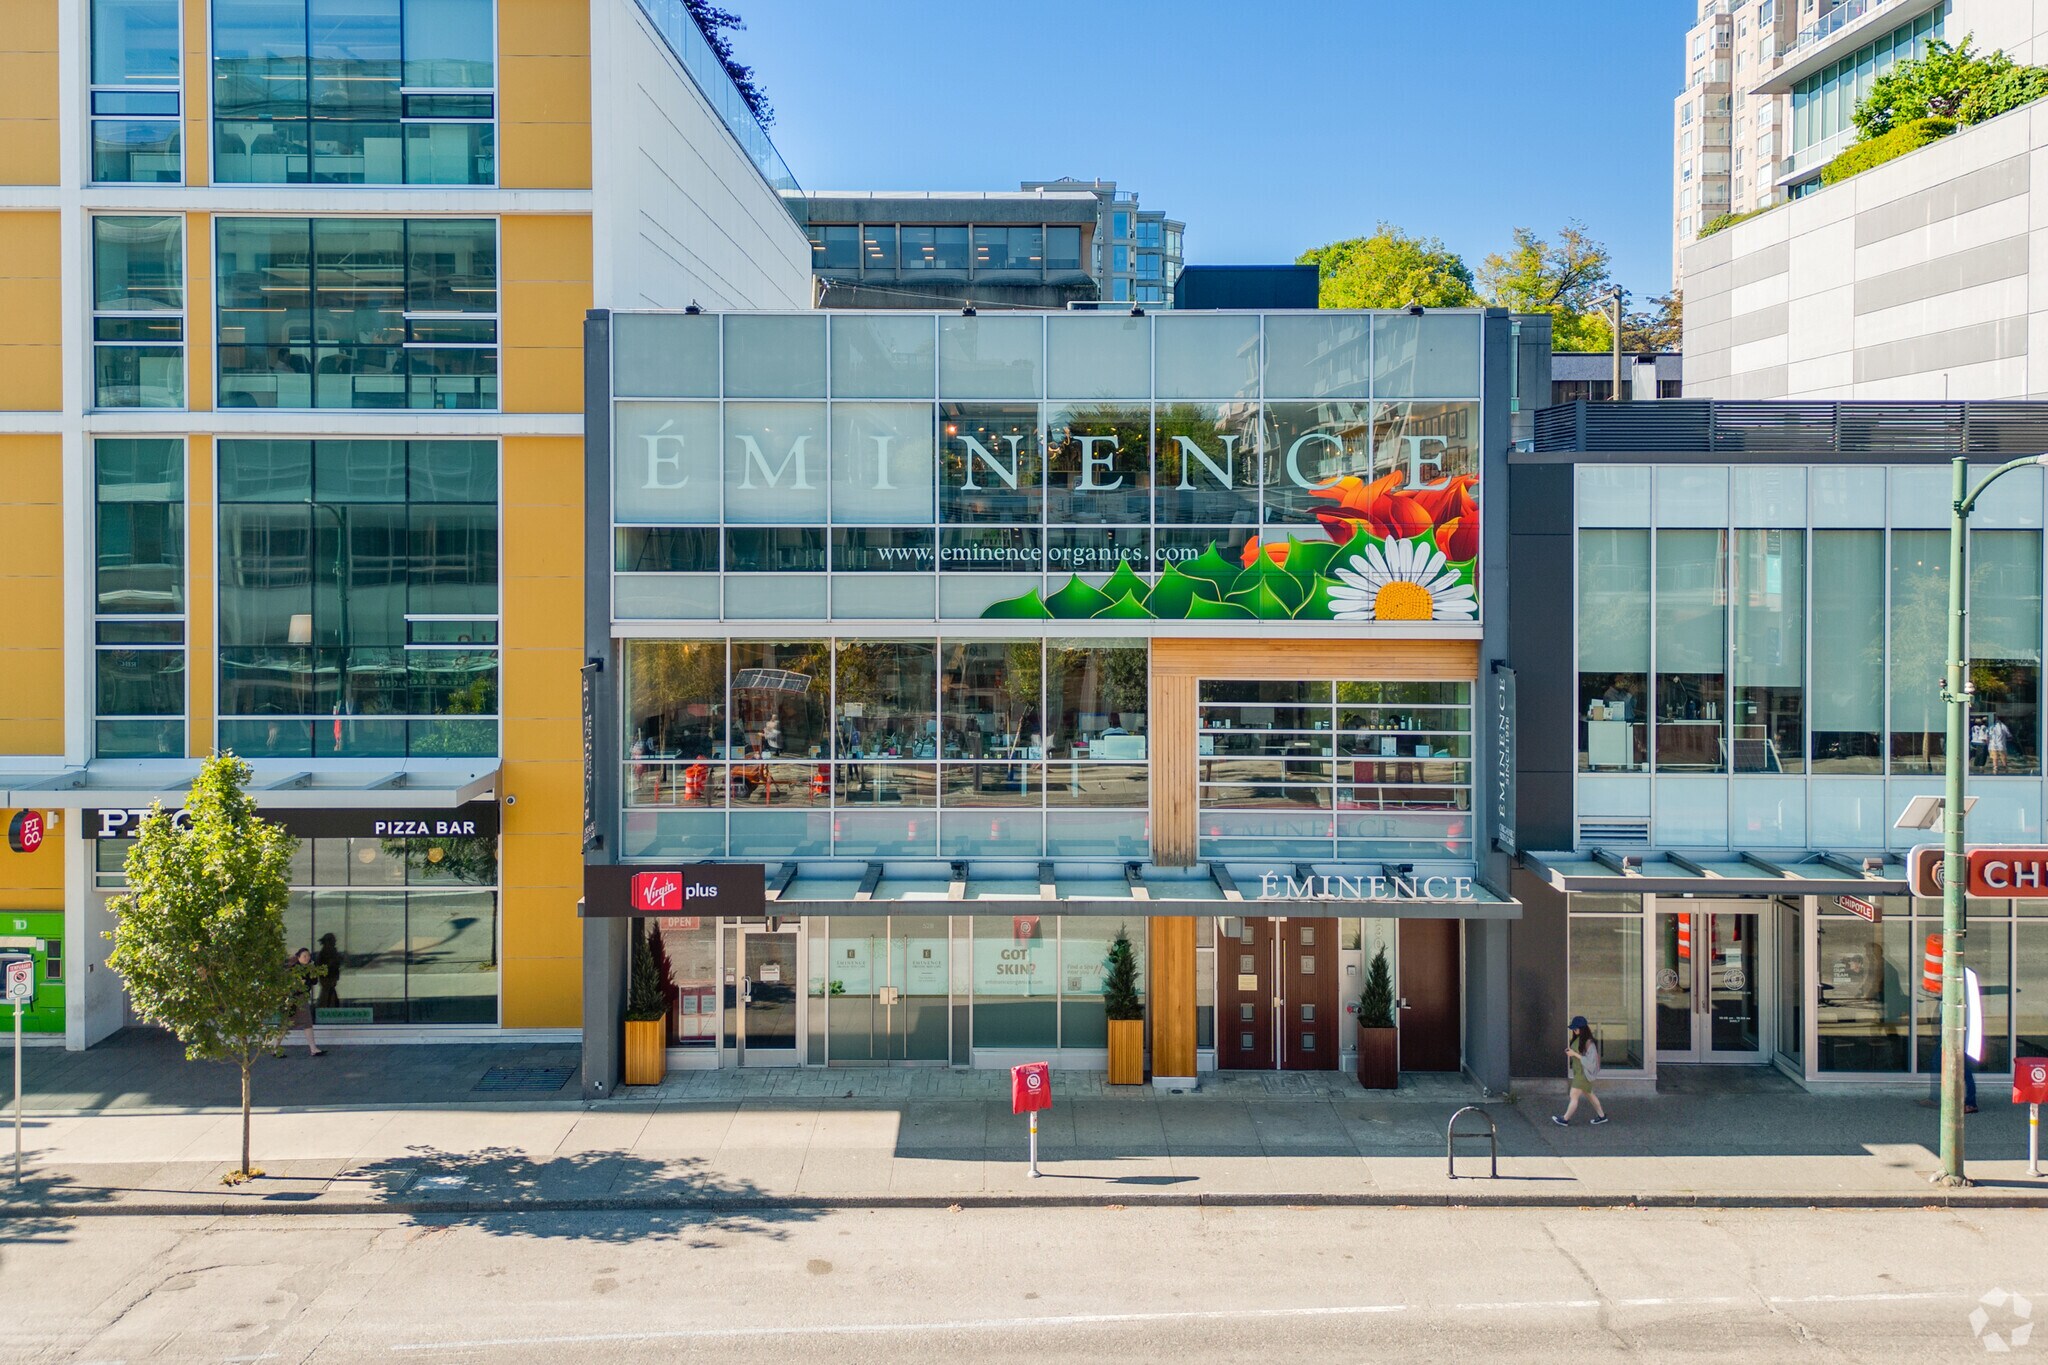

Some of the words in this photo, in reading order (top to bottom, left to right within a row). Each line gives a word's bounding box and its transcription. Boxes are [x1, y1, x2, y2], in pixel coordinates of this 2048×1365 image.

[639, 418, 1452, 492] ÉMINENCE
[24, 817, 40, 834] PI
[374, 820, 431, 836] PIZZA
[435, 820, 476, 835] BAR
[24, 831, 42, 847] CO.
[1983, 860, 2048, 889] CH
[643, 876, 678, 907] Virgin
[685, 882, 718, 900] plus
[1258, 870, 1475, 901] ÉMINENCE
[1840, 896, 1872, 918] CHIPOTLE
[13, 919, 28, 930] TD
[668, 917, 692, 927] OPEN
[1000, 949, 1028, 960] GOT
[996, 963, 1036, 975] SKIN?
